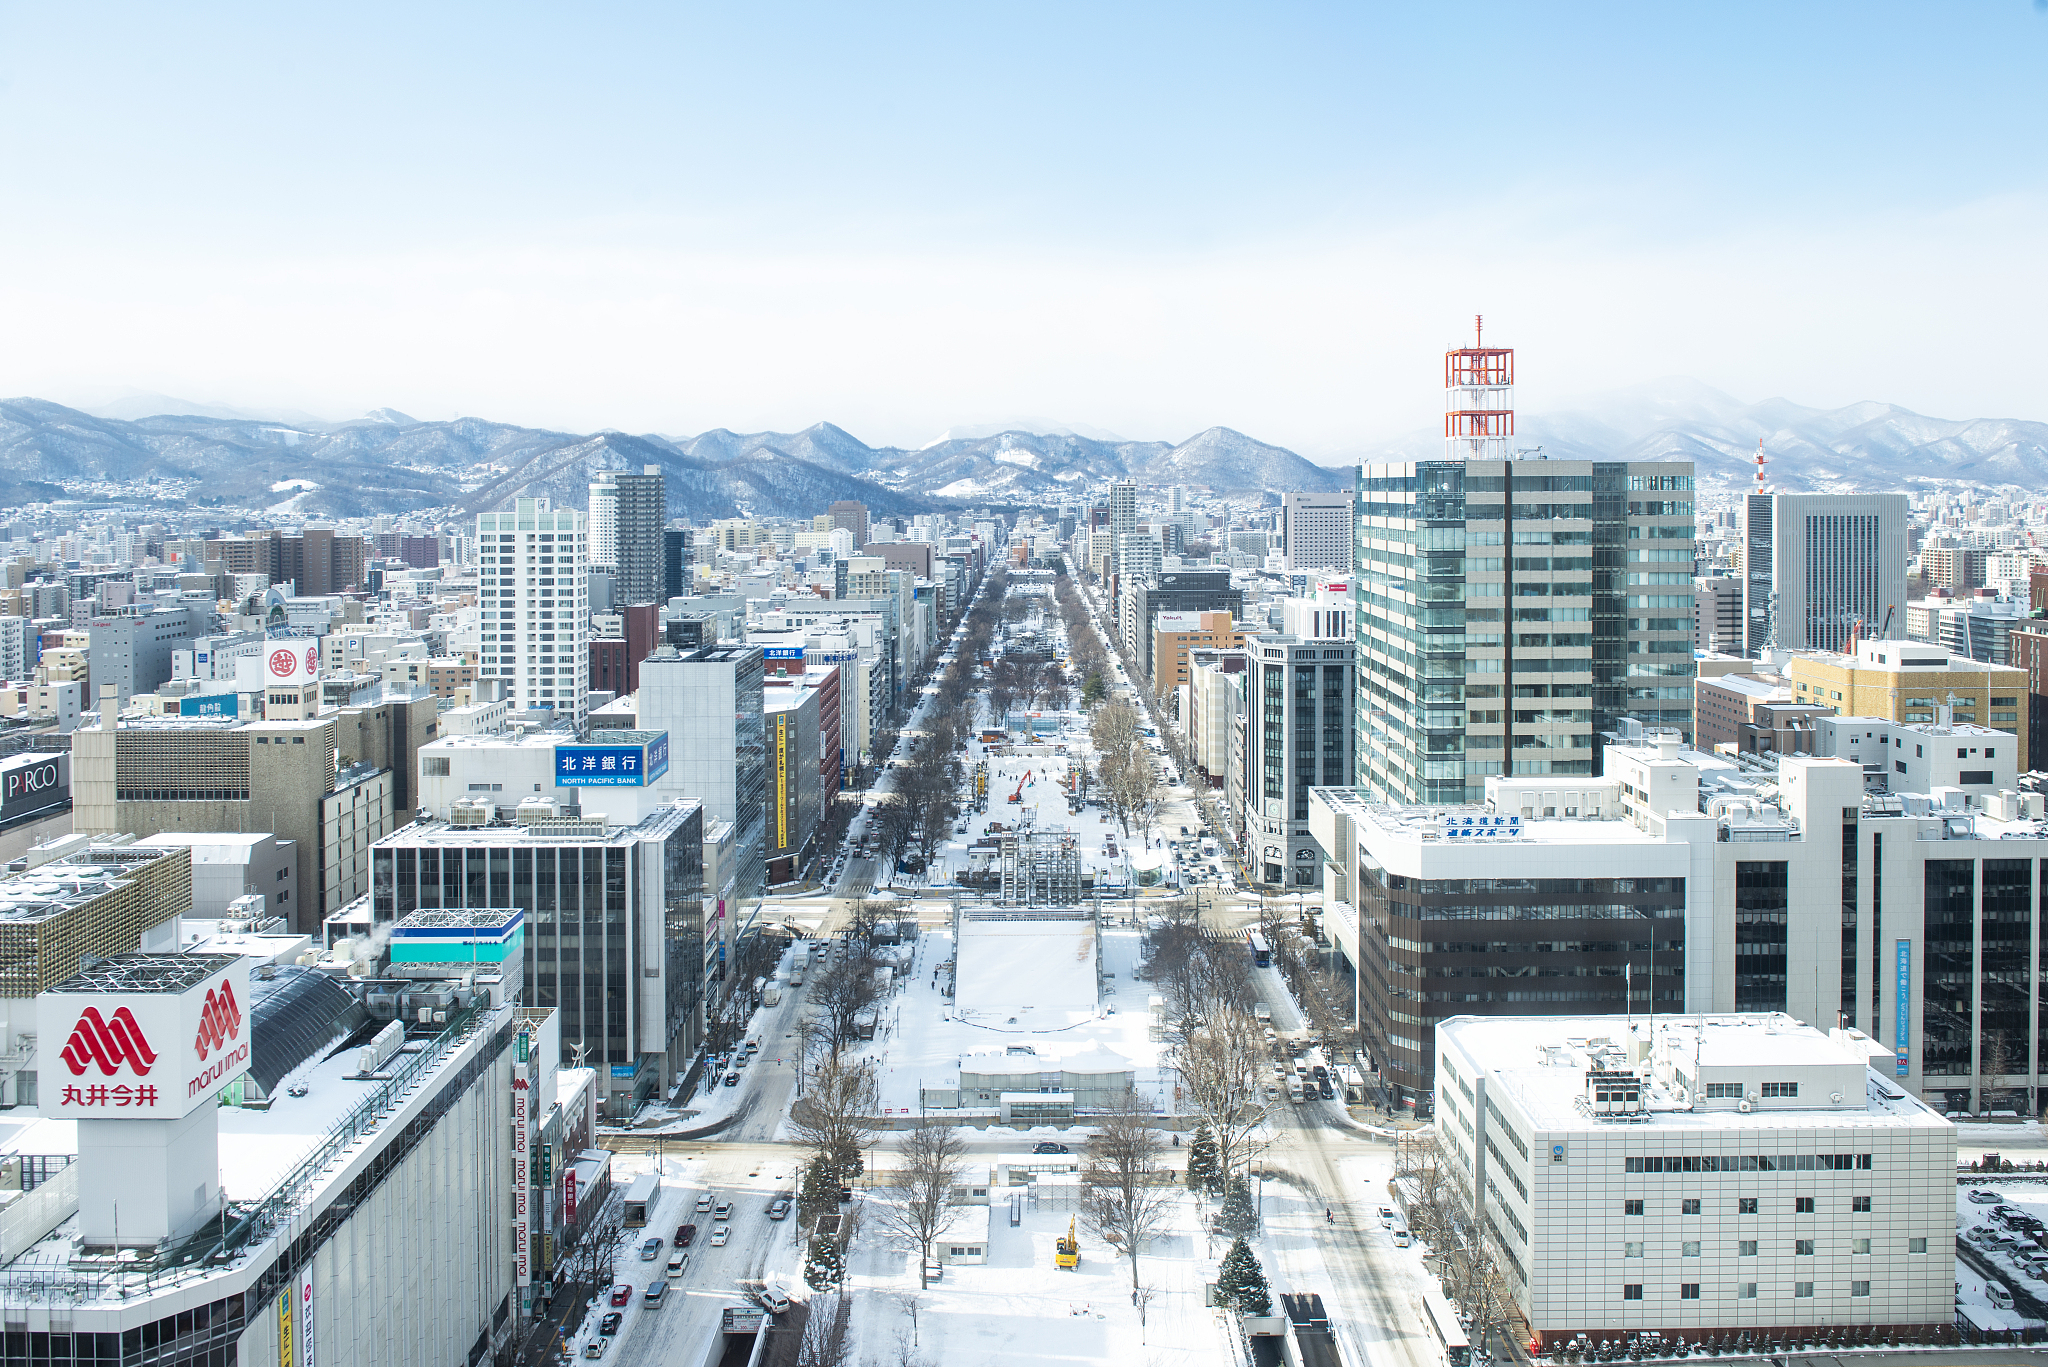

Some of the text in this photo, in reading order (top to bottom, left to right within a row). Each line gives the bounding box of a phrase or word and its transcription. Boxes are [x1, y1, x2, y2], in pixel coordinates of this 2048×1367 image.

[350, 640, 357, 648] P
[271, 651, 295, 675] 越
[562, 756, 636, 771] 北洋銀行
[8, 764, 57, 798] PARCO
[1446, 816, 1519, 825] 北海道新聞
[1447, 828, 1519, 836] 道新スポーツ
[188, 1042, 249, 1098] marui imai
[61, 1084, 159, 1106] 丸井今井
[517, 1098, 525, 1153] marui imai
[517, 1160, 526, 1214] marui imai
[518, 1222, 527, 1276] marui imai
